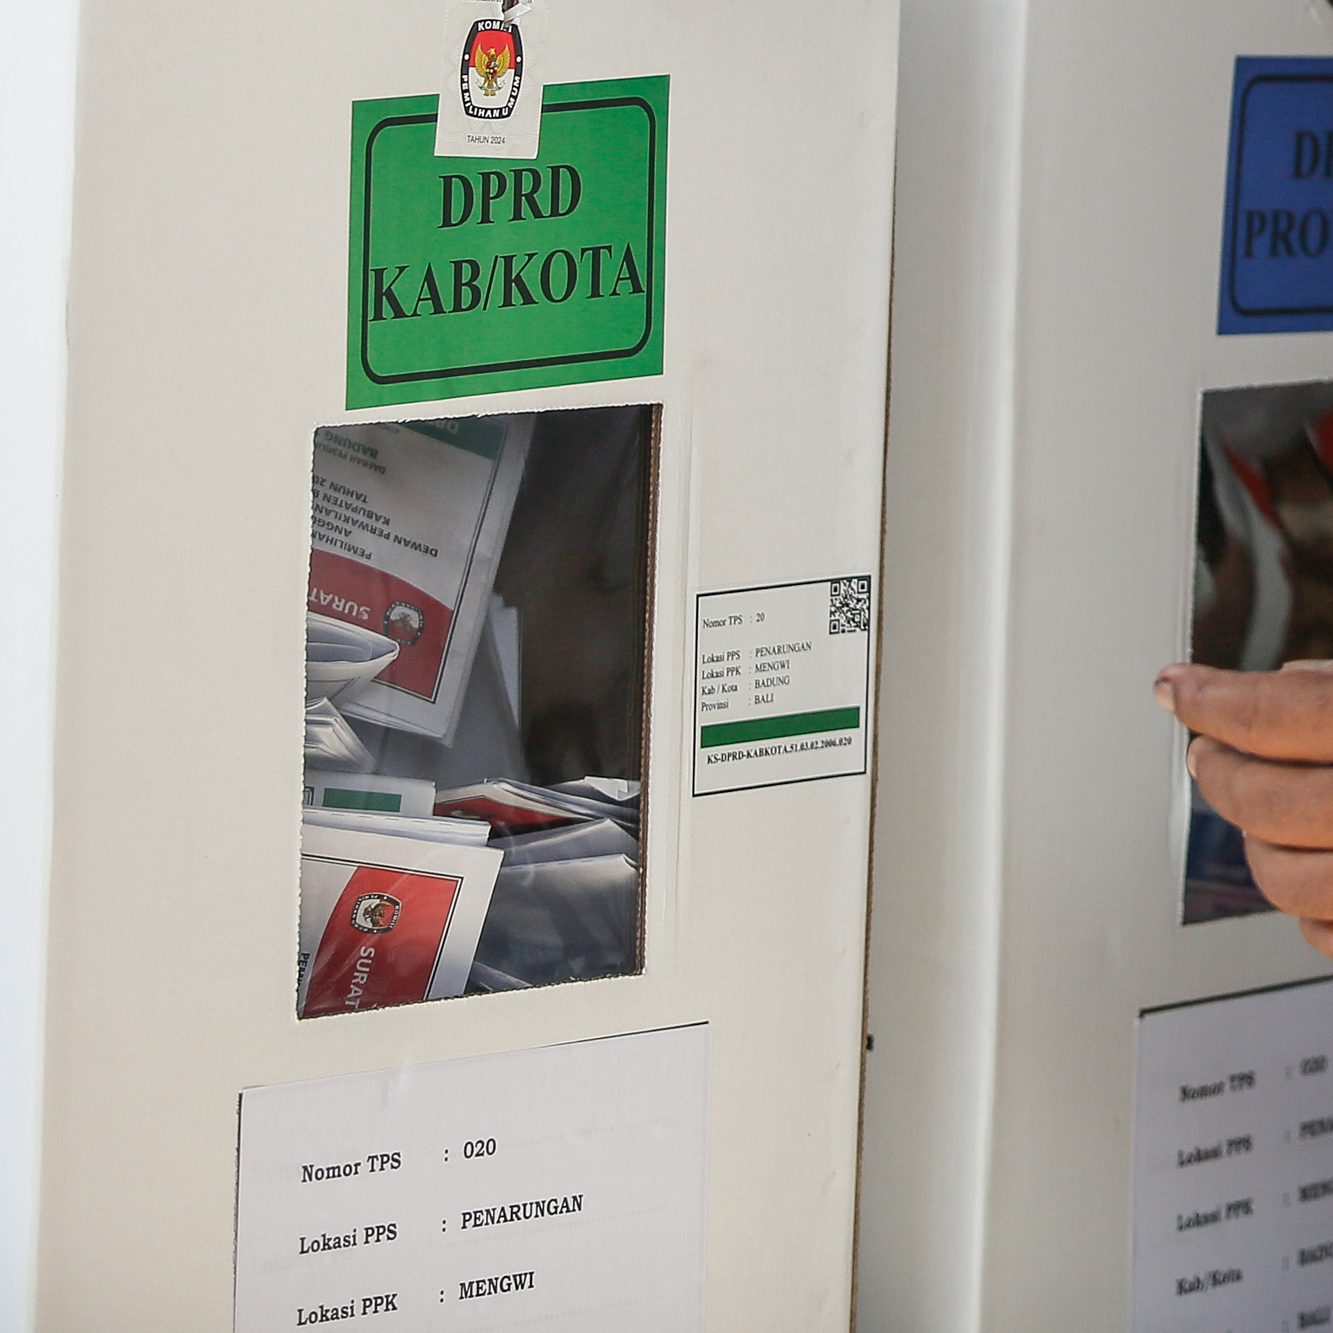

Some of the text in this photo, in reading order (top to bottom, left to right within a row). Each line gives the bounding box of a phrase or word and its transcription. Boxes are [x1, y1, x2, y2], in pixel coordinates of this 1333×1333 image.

[467, 135, 506, 144] TAHUN 2024
[437, 164, 582, 229] DPRD
[368, 243, 646, 322] KAB/KOTA
[329, 481, 368, 503] TAHUN
[323, 494, 391, 527] KABUPATEN
[314, 505, 439, 557] DEWAN PERWAKILAN
[309, 587, 371, 620] SURAT
[702, 617, 726, 629] Nomor
[728, 615, 743, 626] TPS
[755, 612, 765, 622] 20
[702, 651, 725, 664] Lokasi
[726, 650, 741, 661] PPS
[755, 641, 812, 658] PENARUNGAN
[701, 684, 715, 696] Kab
[721, 683, 738, 694] Kota
[755, 675, 790, 688] BADUNG
[702, 667, 725, 680] Lokasi
[725, 666, 741, 677] PPK
[755, 660, 790, 673] MENGWI
[701, 699, 729, 712] Provinsi
[754, 693, 774, 704] BALI
[344, 945, 375, 1009] SURAT
[301, 1160, 361, 1183] Nomor
[367, 1152, 402, 1174] TPS
[463, 1138, 497, 1160] 020
[299, 1230, 358, 1255] Lokasi
[363, 1223, 398, 1246] PPS
[460, 1194, 584, 1230] PENARUNGAN
[297, 1301, 356, 1327] Lokasi
[361, 1294, 399, 1317] PPK
[458, 1271, 536, 1300] MENGWI
